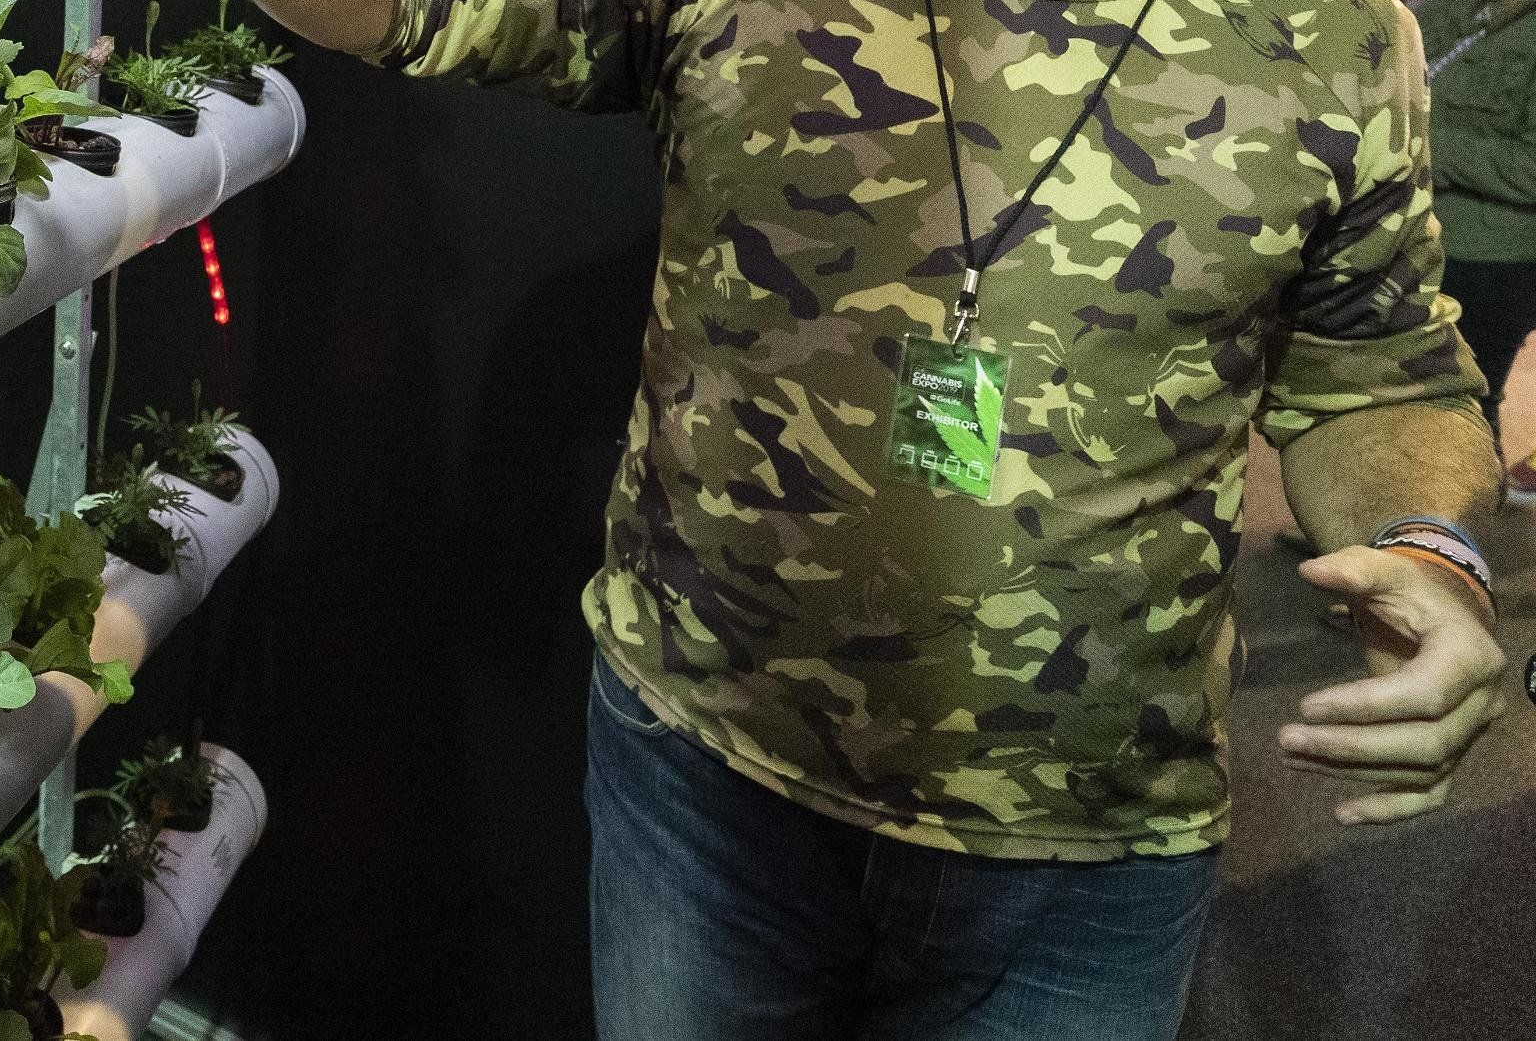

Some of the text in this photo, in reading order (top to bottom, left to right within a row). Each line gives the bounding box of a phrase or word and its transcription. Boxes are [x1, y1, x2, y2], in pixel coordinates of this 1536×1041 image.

[911, 377, 939, 390] EXPO
[912, 371, 963, 389] CANNABIS
[915, 410, 979, 432] EXHIBITOR
